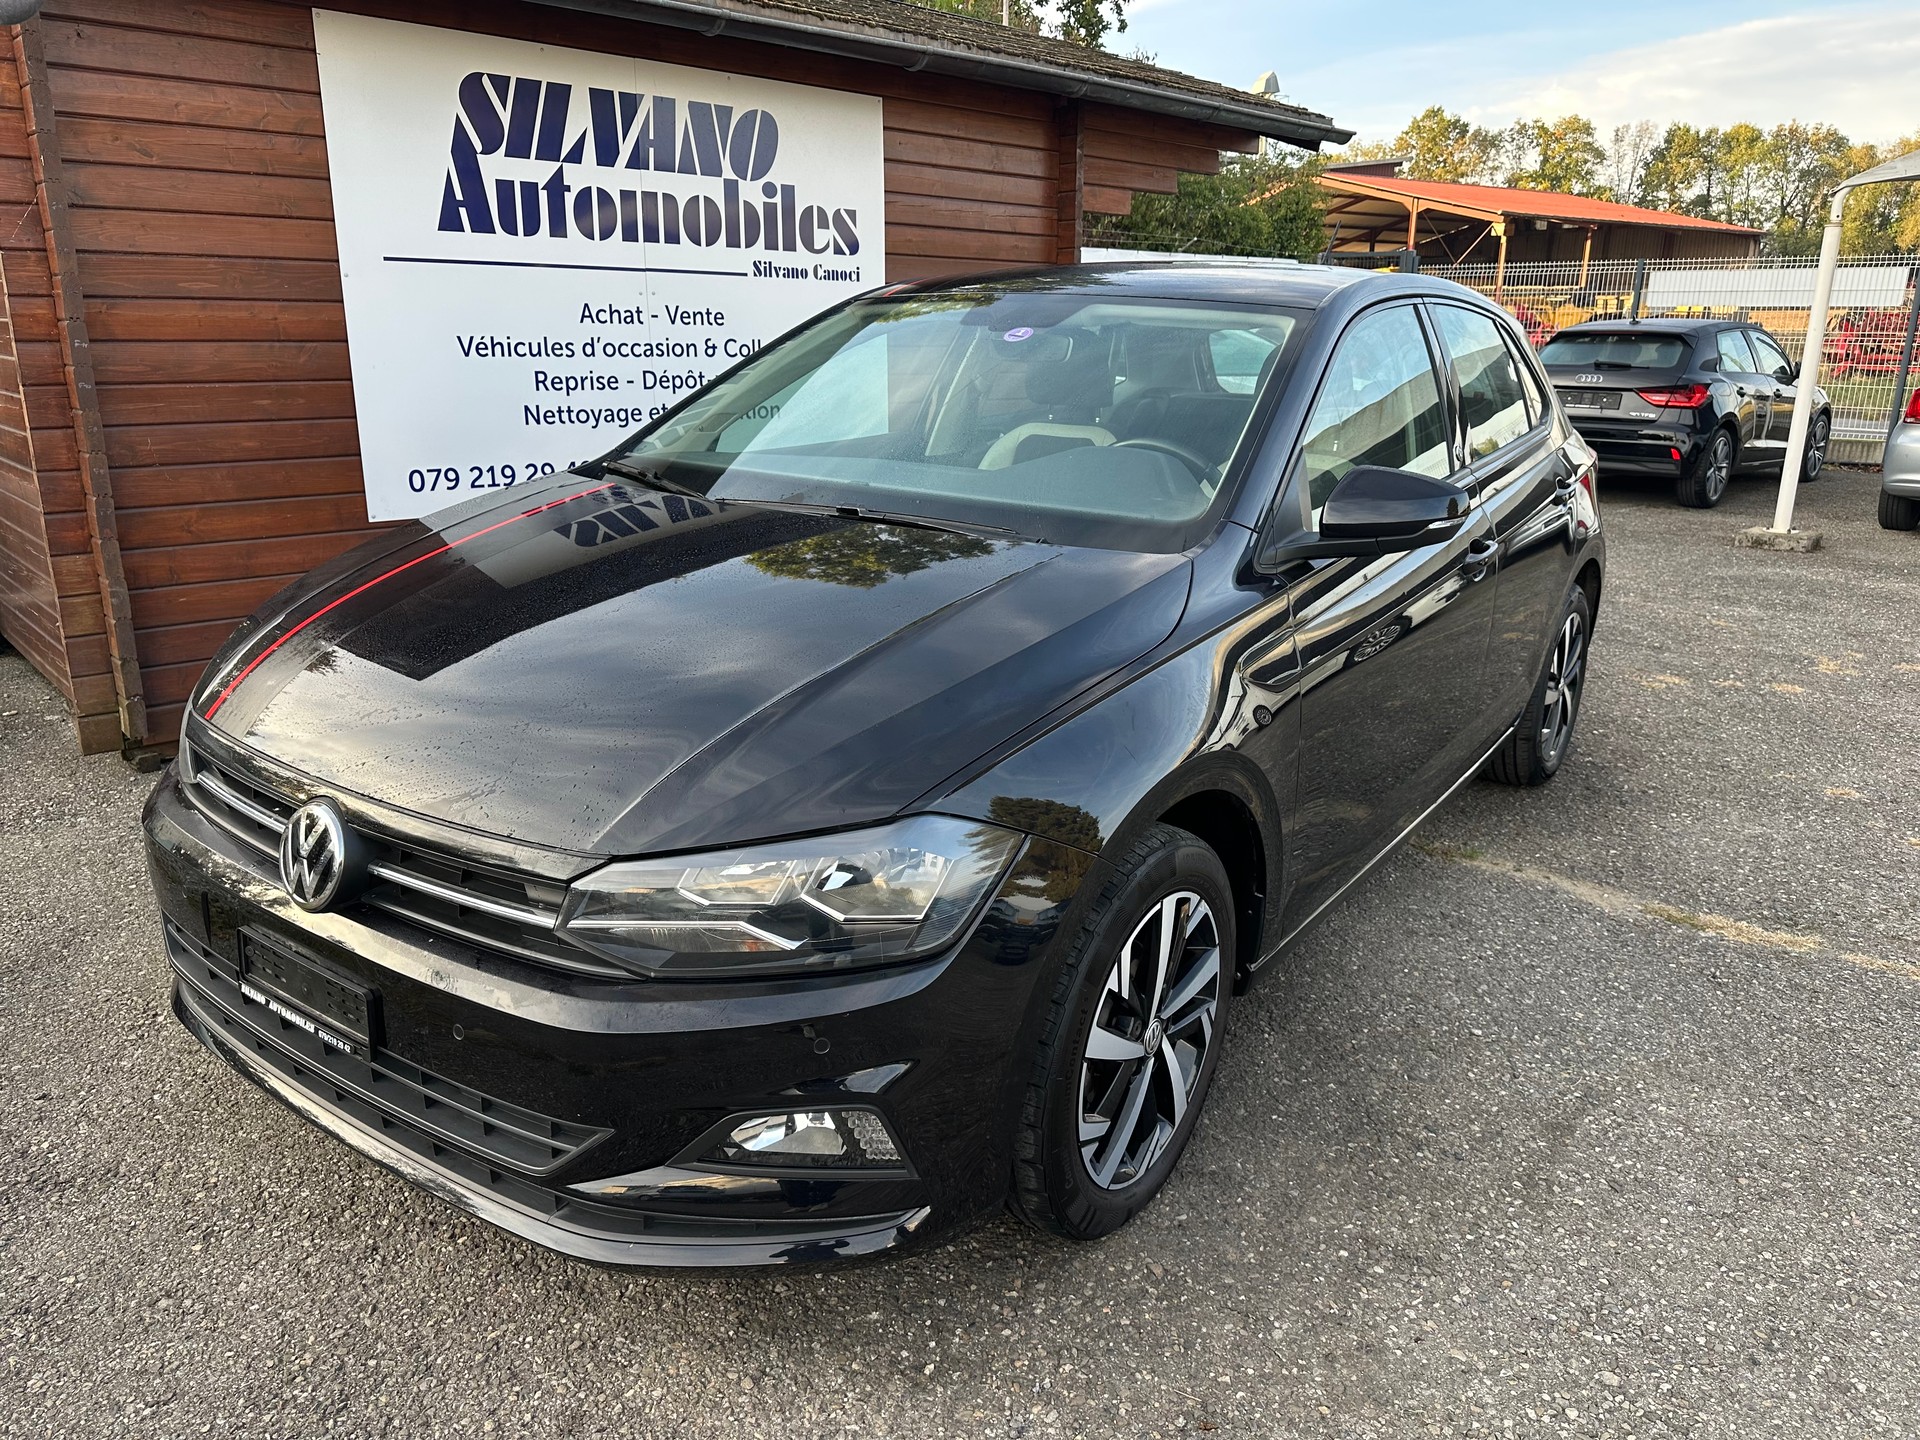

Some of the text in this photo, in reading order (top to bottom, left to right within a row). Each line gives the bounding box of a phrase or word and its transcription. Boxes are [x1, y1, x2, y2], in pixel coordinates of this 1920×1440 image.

[458, 71, 779, 182] SILVANO
[437, 113, 860, 256] Automobiles
[752, 260, 861, 283] Silvano Canoci
[579, 303, 644, 325] Achat
[665, 304, 725, 327] Vente
[456, 335, 761, 359] Véhicules d’occasion & Coll
[534, 370, 619, 396] Reprise
[642, 369, 719, 395] Dépôt-
[523, 404, 643, 430] Nettoyage
[408, 467, 461, 493] 079
[469, 464, 516, 490] 219
